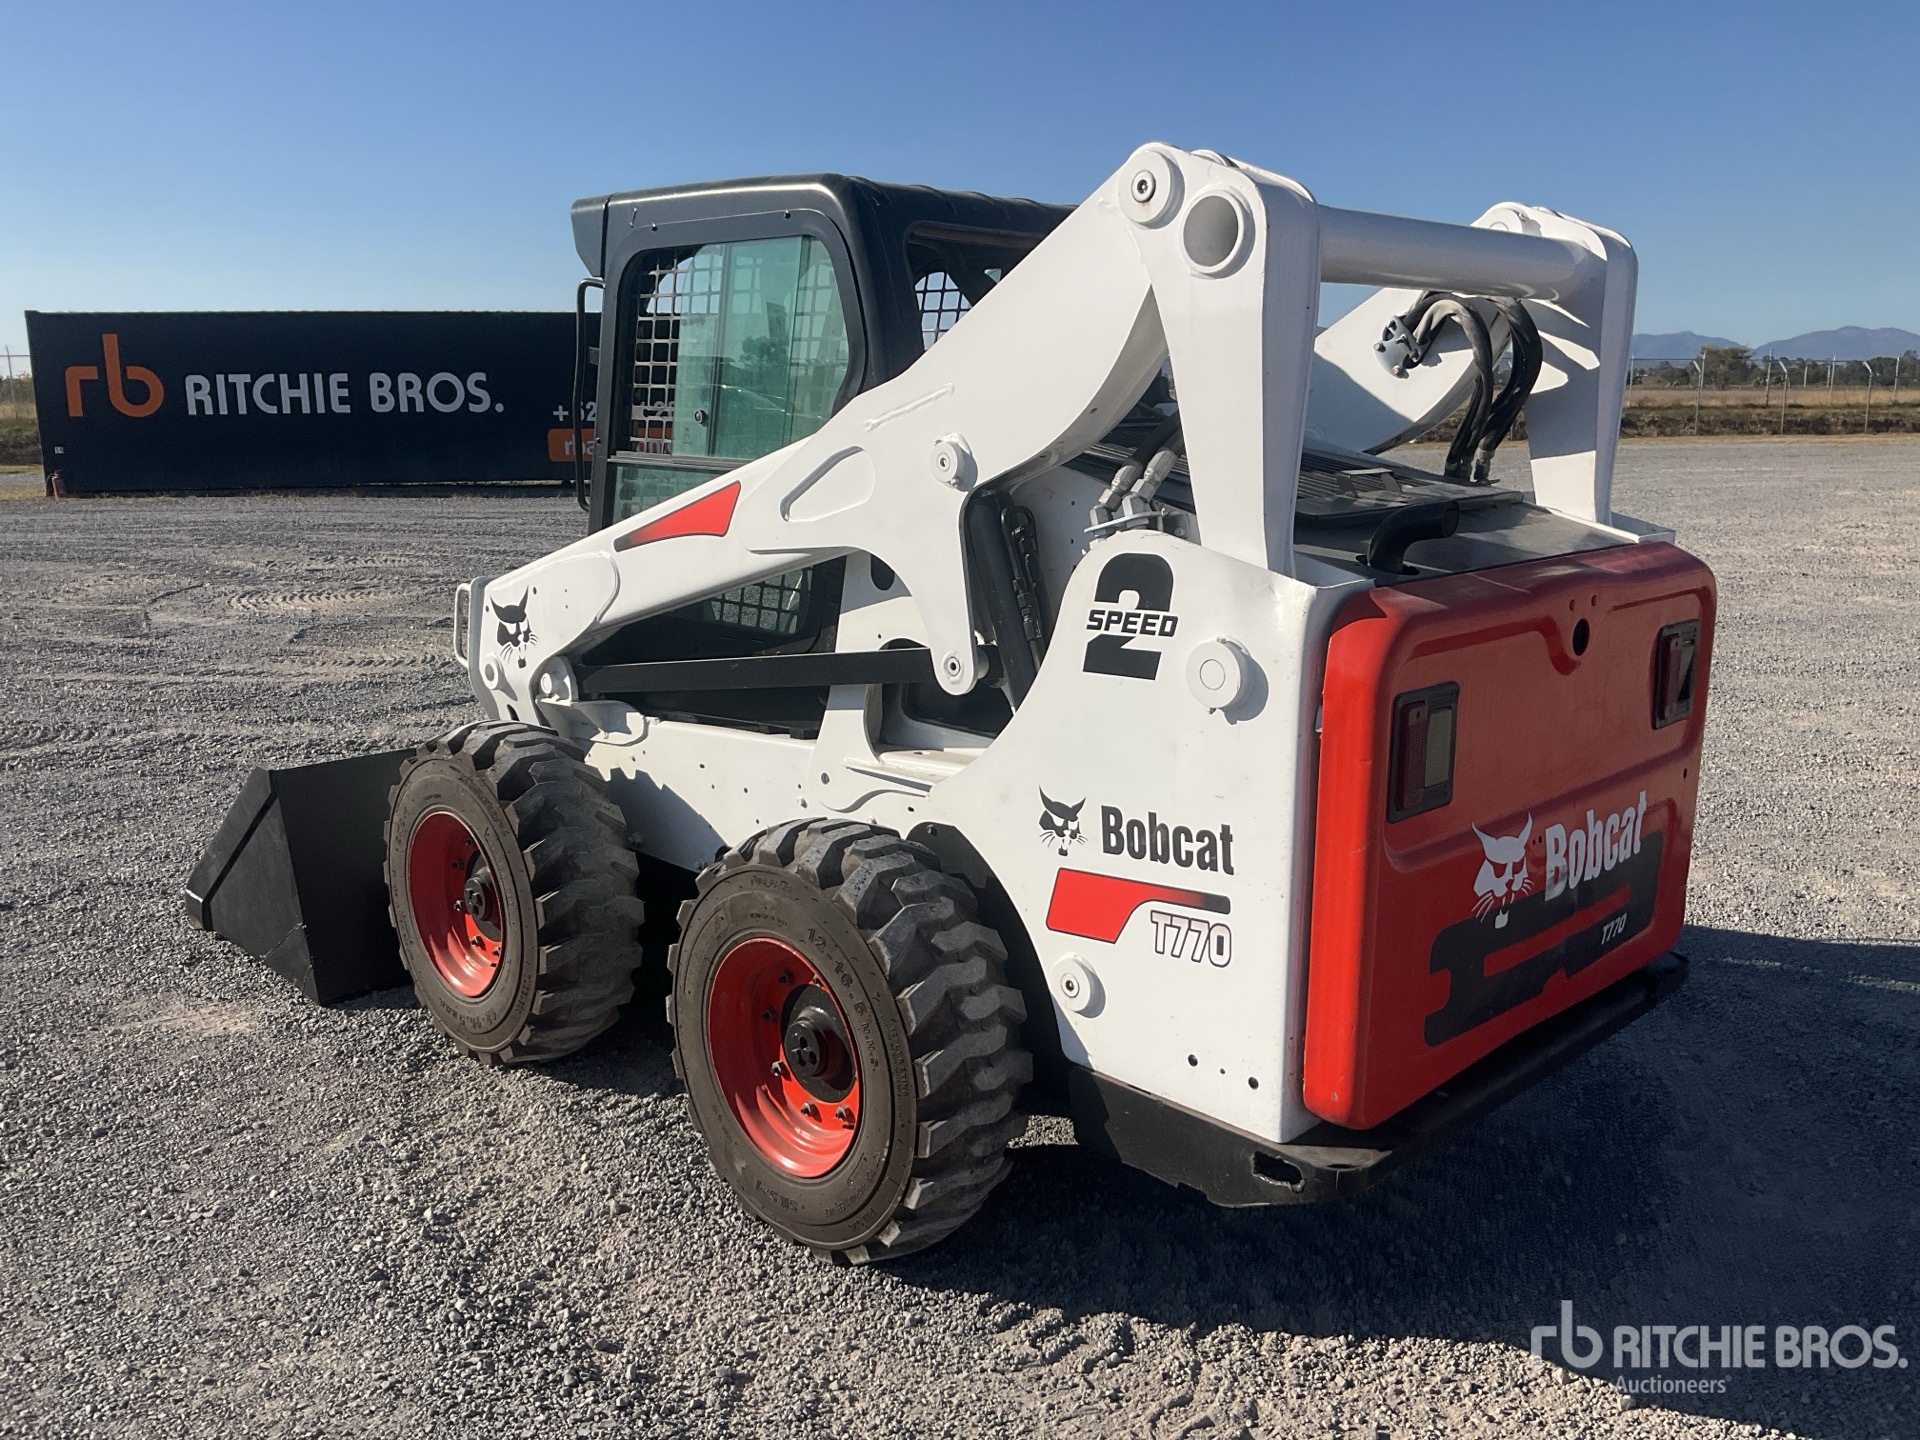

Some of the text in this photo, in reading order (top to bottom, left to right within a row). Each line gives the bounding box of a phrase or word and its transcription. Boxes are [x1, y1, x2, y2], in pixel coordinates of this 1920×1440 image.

[65, 333, 165, 418] rb
[186, 371, 505, 415] RITCHIE BROS.
[1083, 552, 1174, 681] 2
[1086, 609, 1179, 637] SPEED
[1101, 804, 1234, 876] Bobcat
[1545, 790, 1647, 902] Bobcat
[1150, 910, 1232, 968] T770
[1601, 912, 1628, 945] T770
